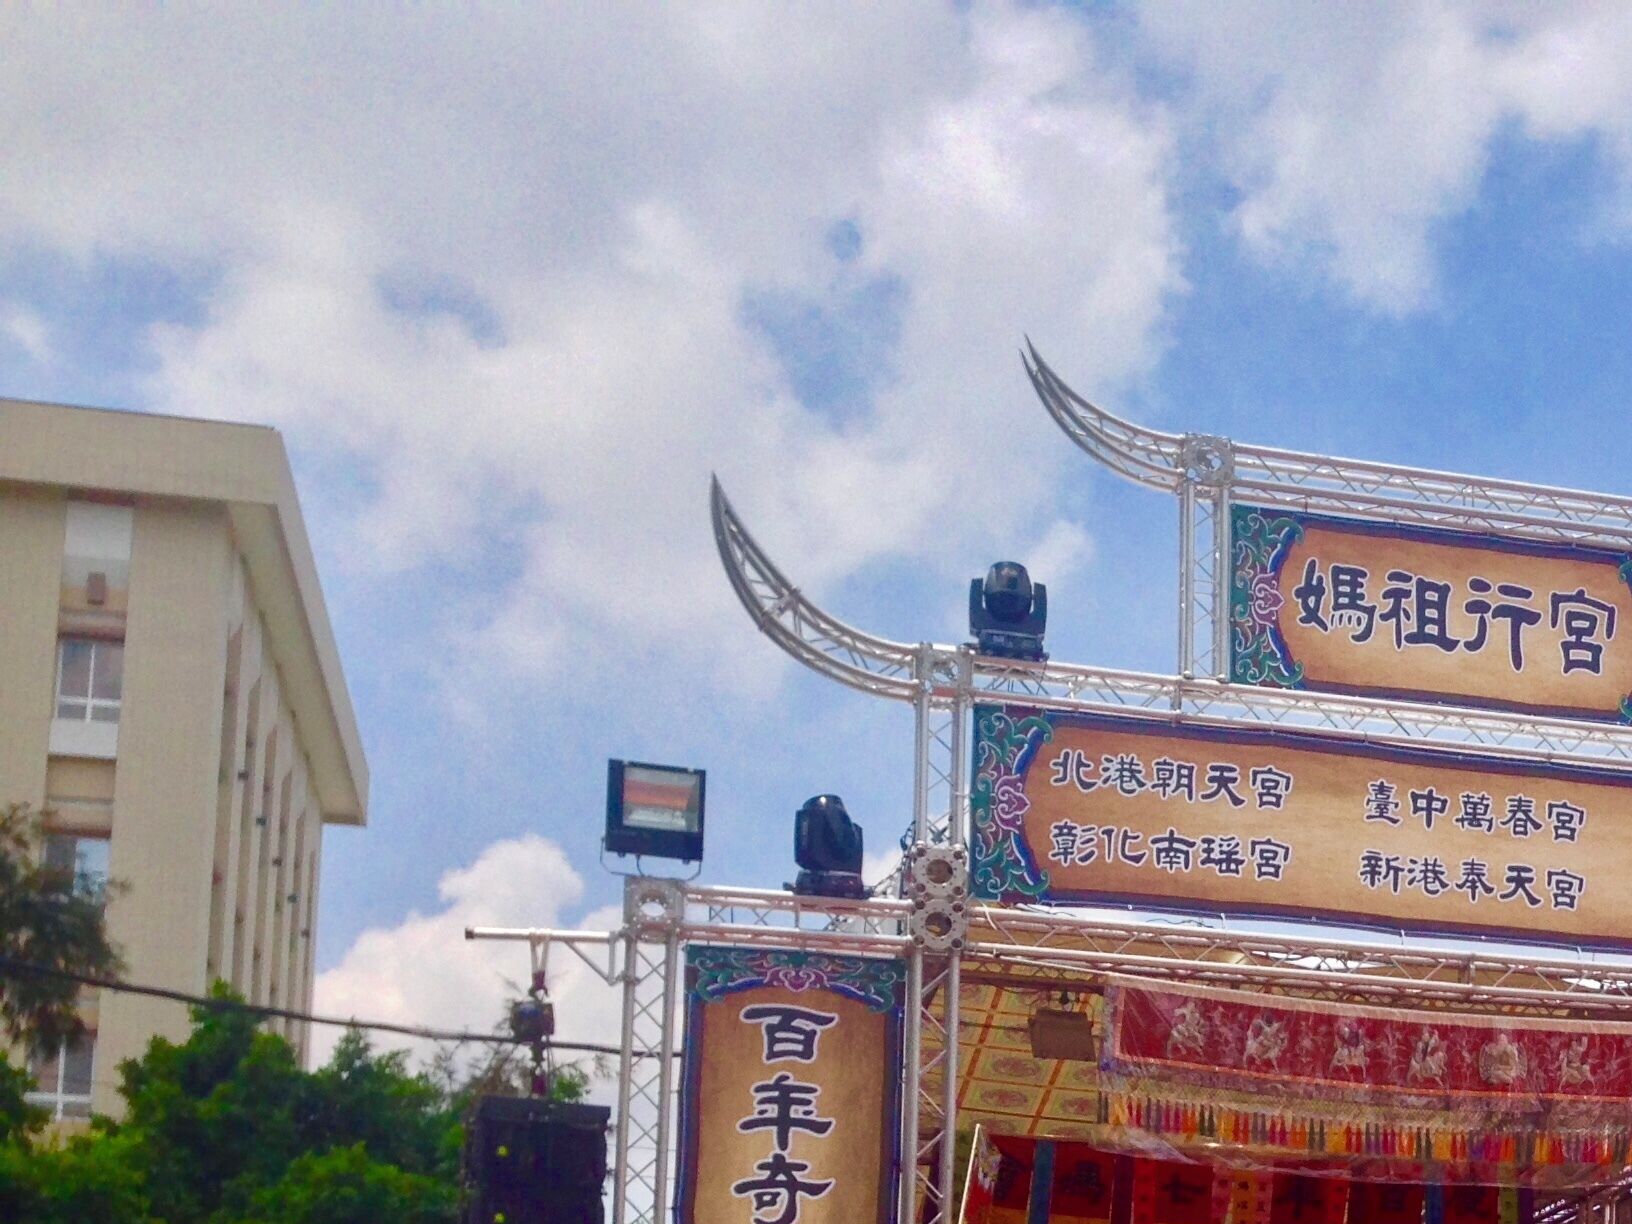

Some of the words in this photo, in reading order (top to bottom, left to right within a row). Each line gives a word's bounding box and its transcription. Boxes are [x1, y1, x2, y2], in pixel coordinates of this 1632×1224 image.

[1294, 558, 1616, 674] 媽祖行宮
[1051, 750, 1292, 808] 北港朝天宮
[1365, 780, 1584, 842] 臺中萬春宮
[1359, 850, 1584, 909] 新港奉天宮
